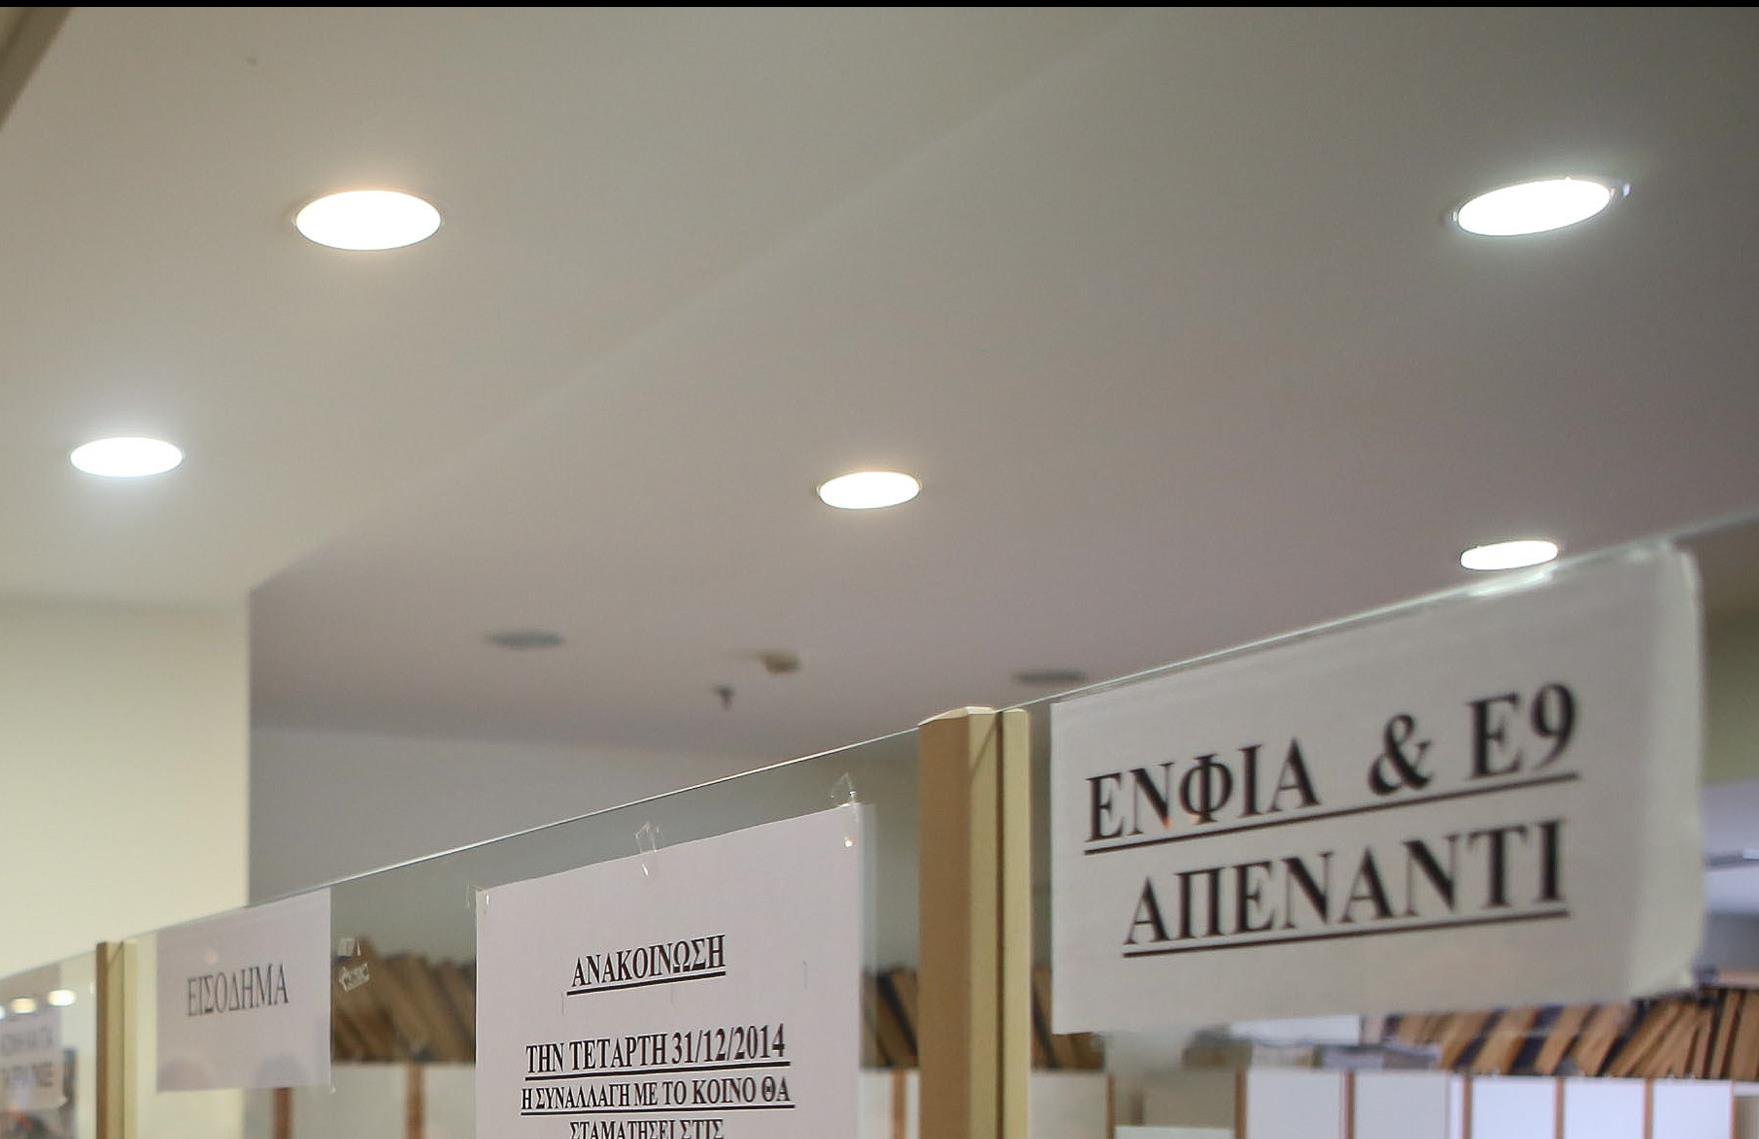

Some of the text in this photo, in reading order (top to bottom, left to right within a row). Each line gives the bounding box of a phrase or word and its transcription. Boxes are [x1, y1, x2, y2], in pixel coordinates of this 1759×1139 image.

[1085, 683, 1579, 843] ΕΝΦΙΑ & Ε9
[1123, 818, 1567, 946] ΑΠΕΝΑΝΤΙ
[571, 934, 726, 988] ΑΝΑΚΟΙΝΩΣΗ
[186, 962, 289, 1017] ΕΙΣΟΔΗΜΑ
[525, 1023, 786, 1074] ΤΗΝ ΤΕΤΑΡΤΗ 31/12/2014
[521, 1075, 790, 1110] Η ΣΥΝΑΛΛΑΓΗ ΜΕ ΤΟ ΚΟΙΝΟ ΘΑ
